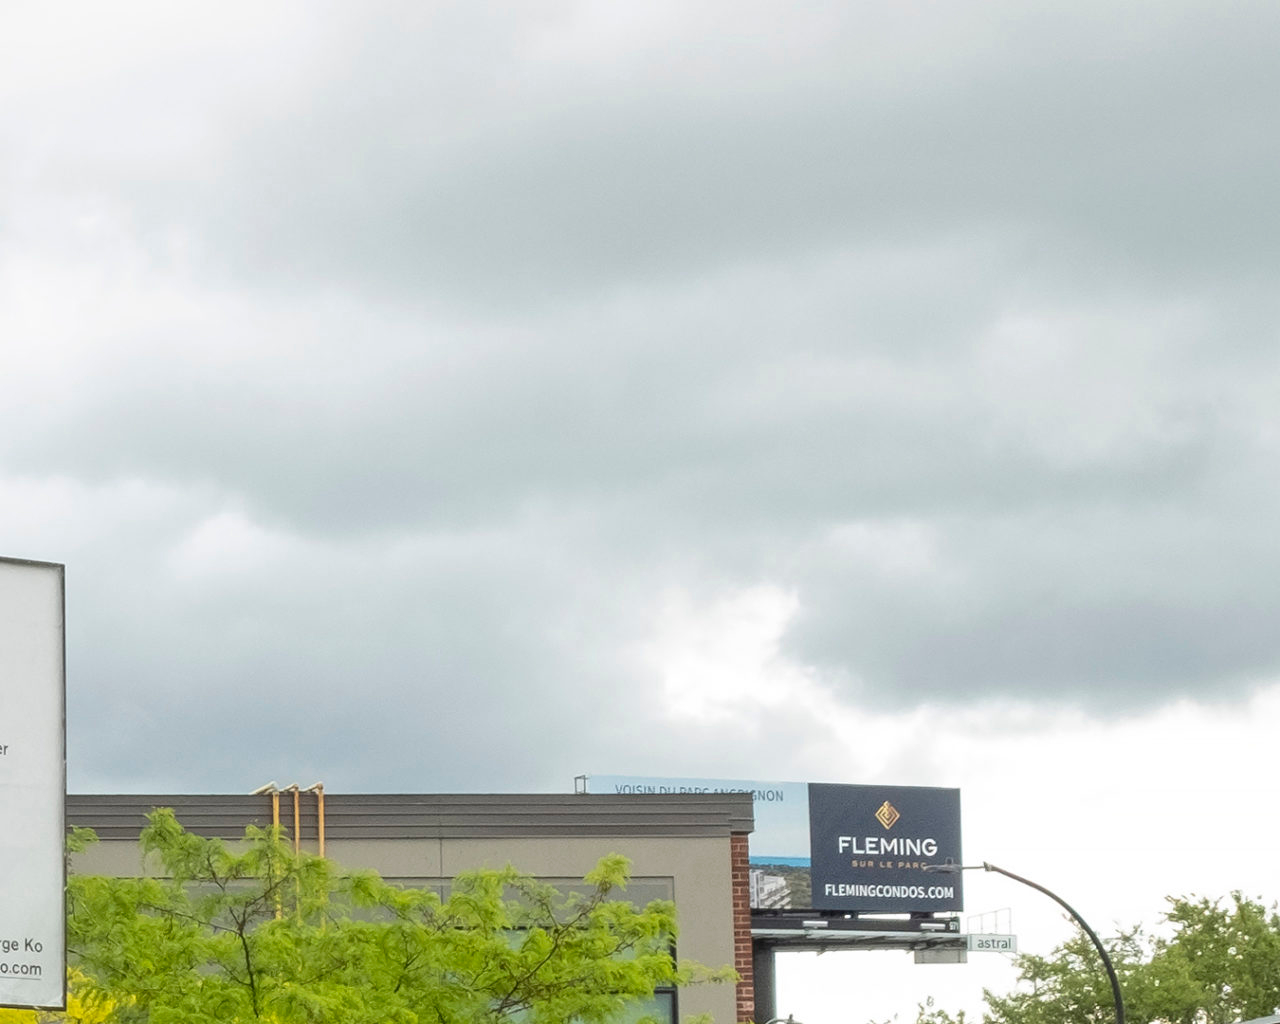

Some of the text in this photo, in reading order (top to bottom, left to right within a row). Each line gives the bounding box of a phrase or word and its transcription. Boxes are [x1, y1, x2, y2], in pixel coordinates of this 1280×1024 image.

[838, 835, 939, 857] FLEMING
[851, 859, 928, 872] SUR LE PARC
[825, 883, 955, 899] FLEMINGCONDOS.COM
[24, 937, 44, 953] Ko
[977, 937, 1012, 949] astral
